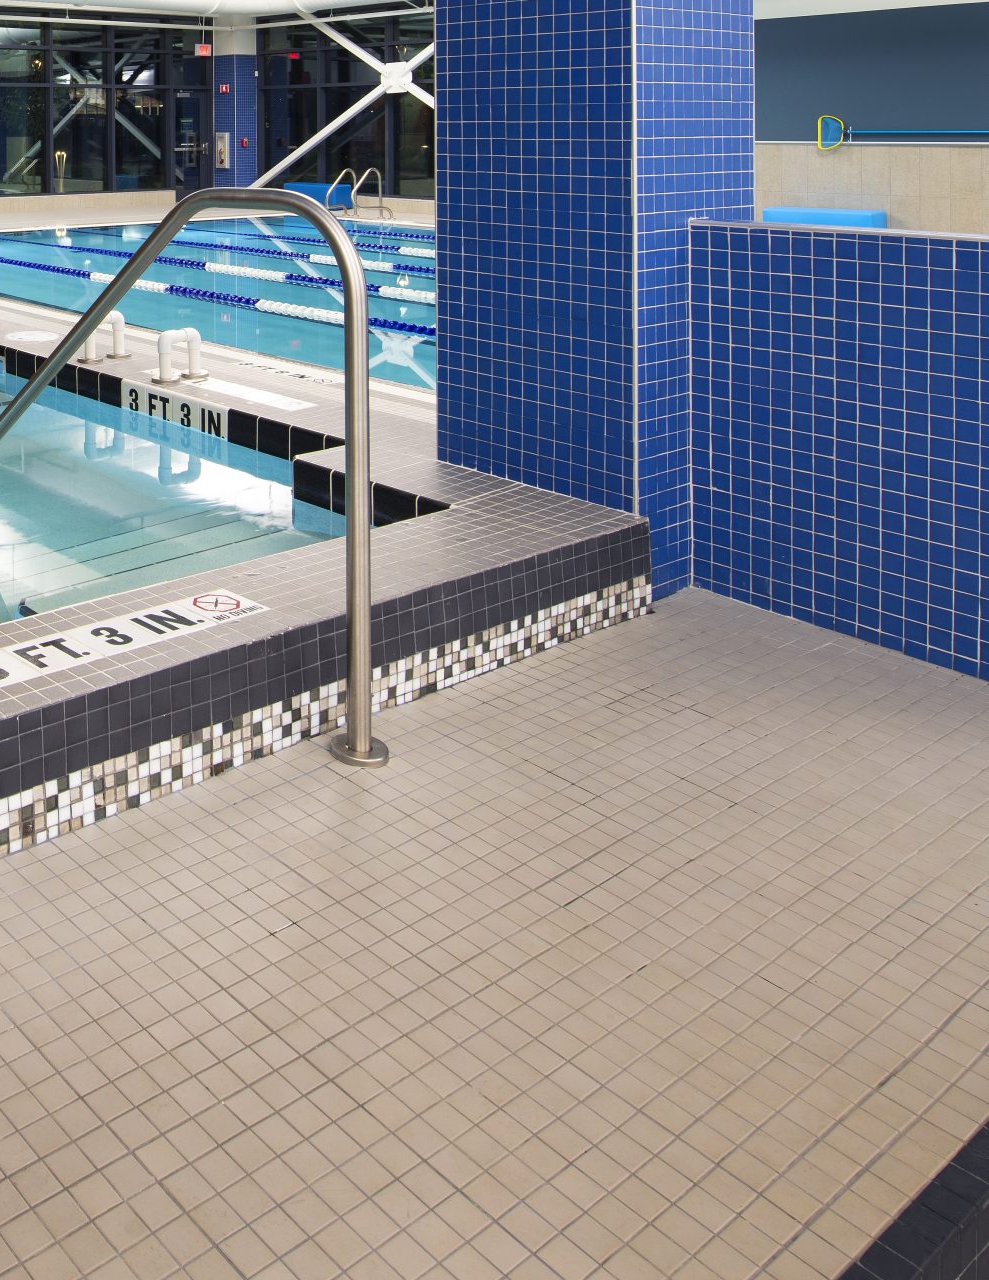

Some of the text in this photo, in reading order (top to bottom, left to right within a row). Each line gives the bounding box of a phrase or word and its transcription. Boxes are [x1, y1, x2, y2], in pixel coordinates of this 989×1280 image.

[129, 388, 139, 411] 3
[180, 402, 191, 427] 3
[12, 637, 91, 669] FT.
[91, 626, 133, 646] 3
[130, 609, 205, 635] IN.
